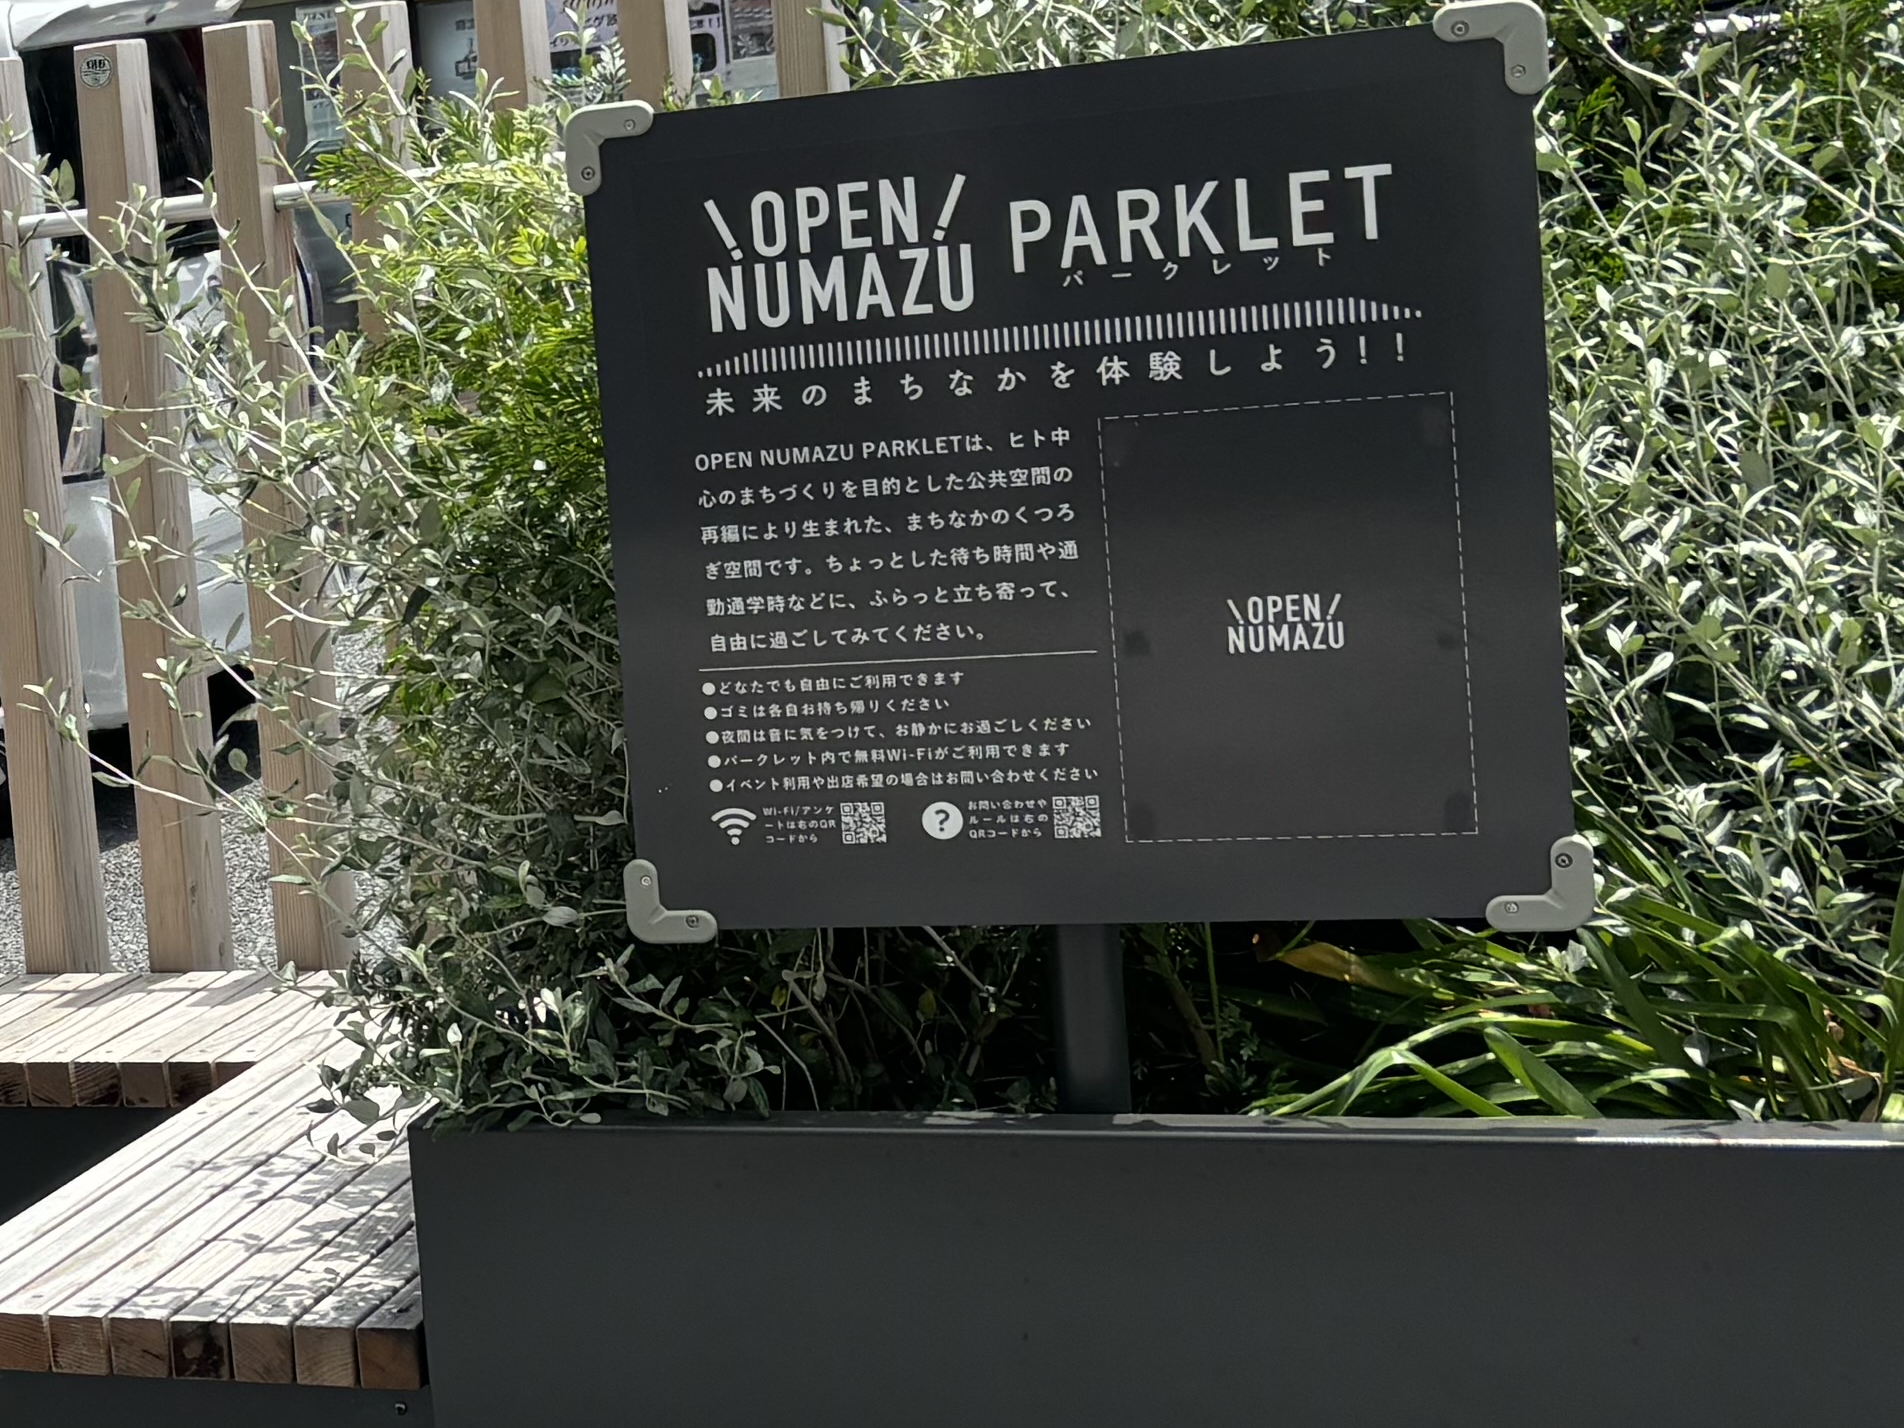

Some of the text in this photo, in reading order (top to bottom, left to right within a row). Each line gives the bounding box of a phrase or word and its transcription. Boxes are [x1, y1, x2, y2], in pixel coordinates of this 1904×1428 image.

[1009, 163, 1393, 274] PARKLET
[1062, 247, 1332, 287] パークレット
[707, 244, 975, 333] NUMAZU
[695, 451, 753, 472] OPEN
[760, 444, 854, 468] NUMAZU
[698, 466, 1073, 508] 心のまちづくりを目的とした公共空間の
[700, 503, 1075, 544] 再編により生まれた、まちなかのくつろ
[705, 540, 1079, 581] ぎ空間です。ちょっとした待ち時間や通
[710, 622, 984, 653] 自由に過ごしてみてください。
[1227, 621, 1345, 654] NUMAZU
